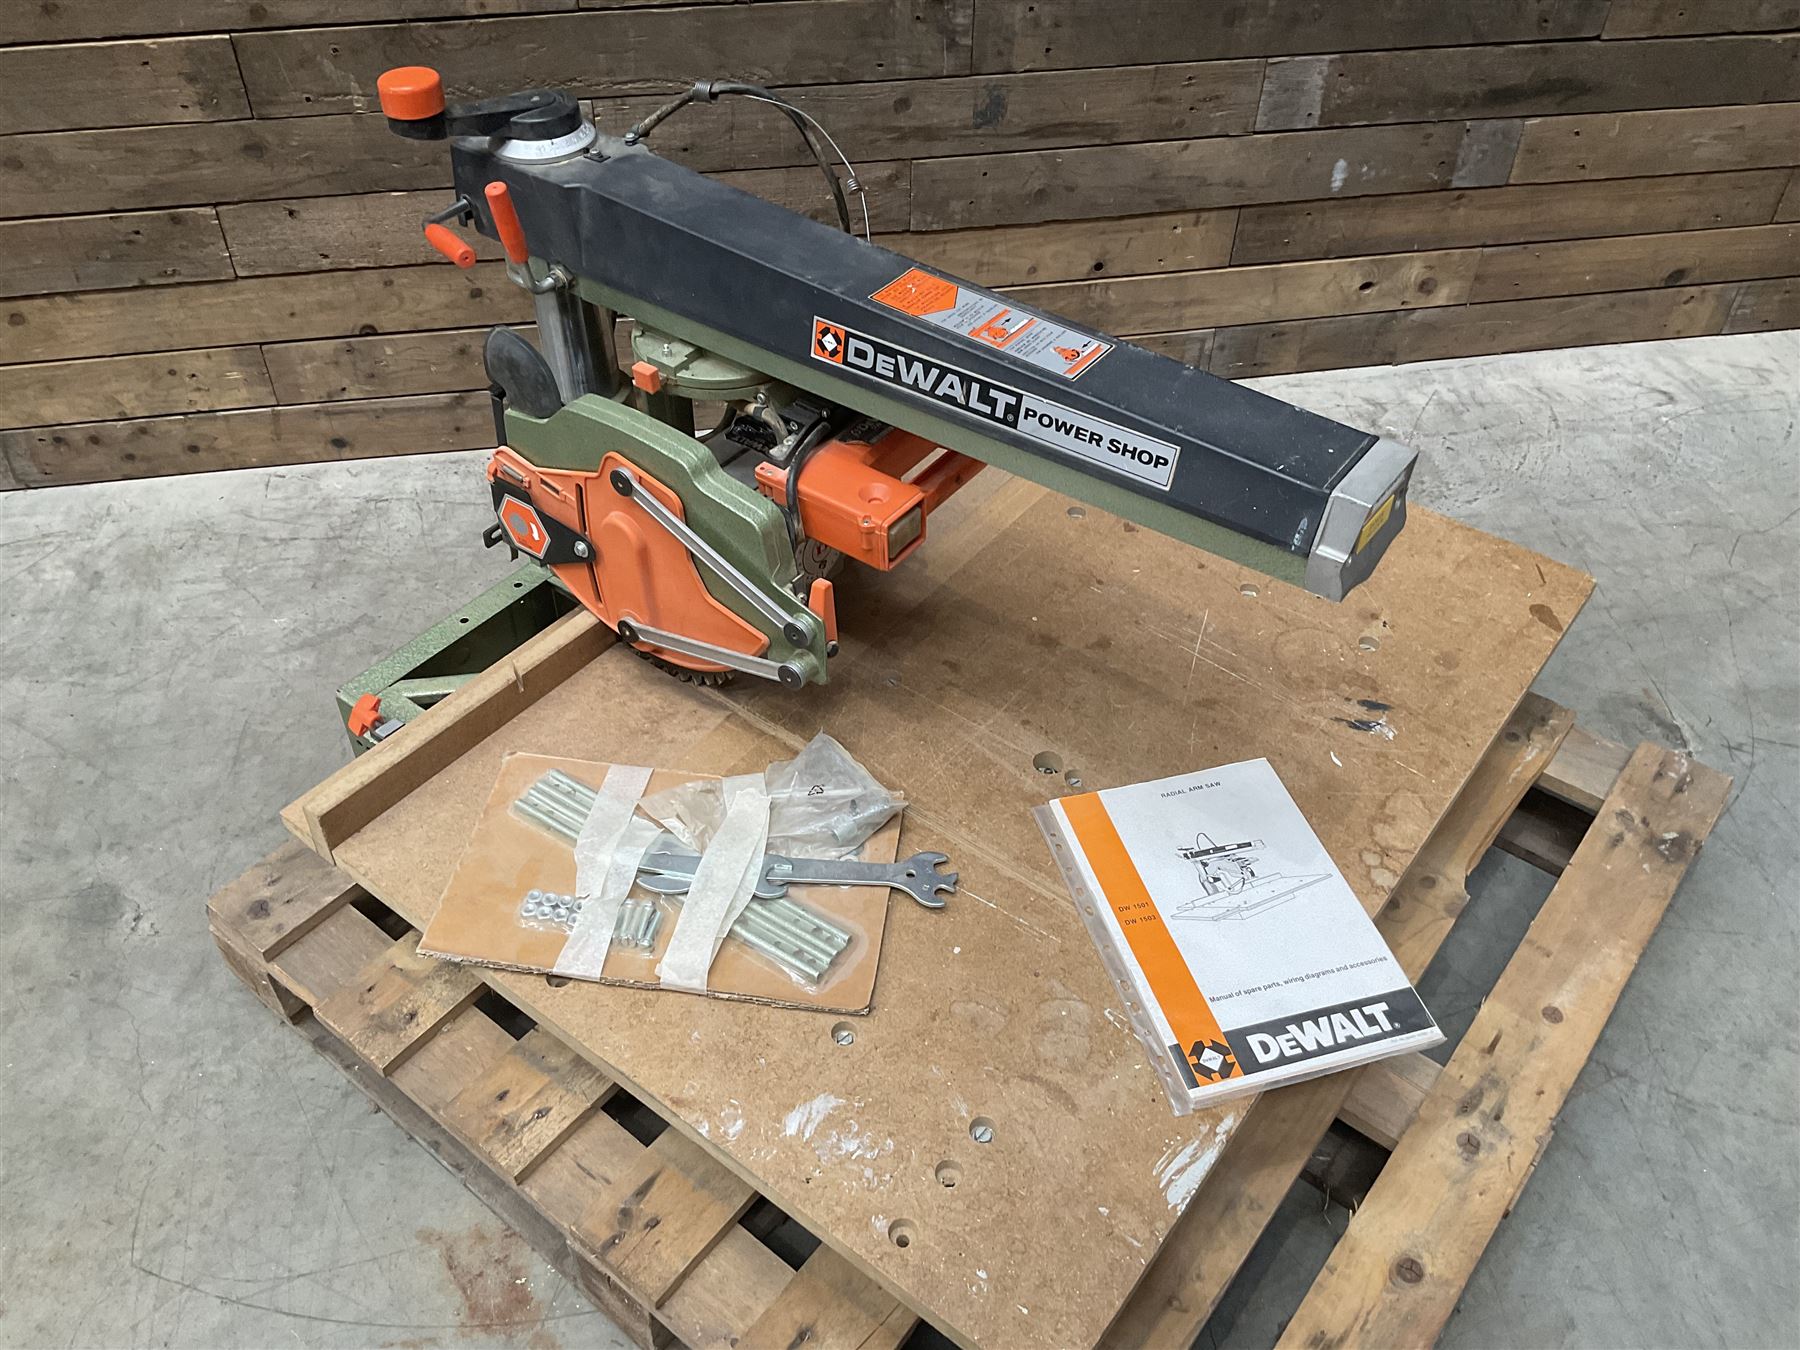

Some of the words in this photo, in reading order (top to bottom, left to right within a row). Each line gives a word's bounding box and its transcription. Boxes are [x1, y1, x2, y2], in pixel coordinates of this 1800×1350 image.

[1023, 406, 1103, 448] POWER
[1106, 438, 1169, 469] SHOP
[1160, 789, 1186, 798] RADIAL
[1188, 784, 1204, 793] ARM
[1204, 781, 1221, 789] SAW
[1118, 904, 1131, 912] DW
[1133, 901, 1149, 910] 1501
[1124, 918, 1137, 926] DW
[1139, 914, 1156, 923] 1503
[1209, 992, 1234, 1003] Manual
[1235, 990, 1243, 998] of
[1243, 985, 1263, 995] spare
[1263, 981, 1283, 992] parts,
[1283, 974, 1305, 985] wiring
[1304, 968, 1336, 981] diagrams
[1335, 964, 1349, 973] and
[1349, 955, 1388, 970] accessories
